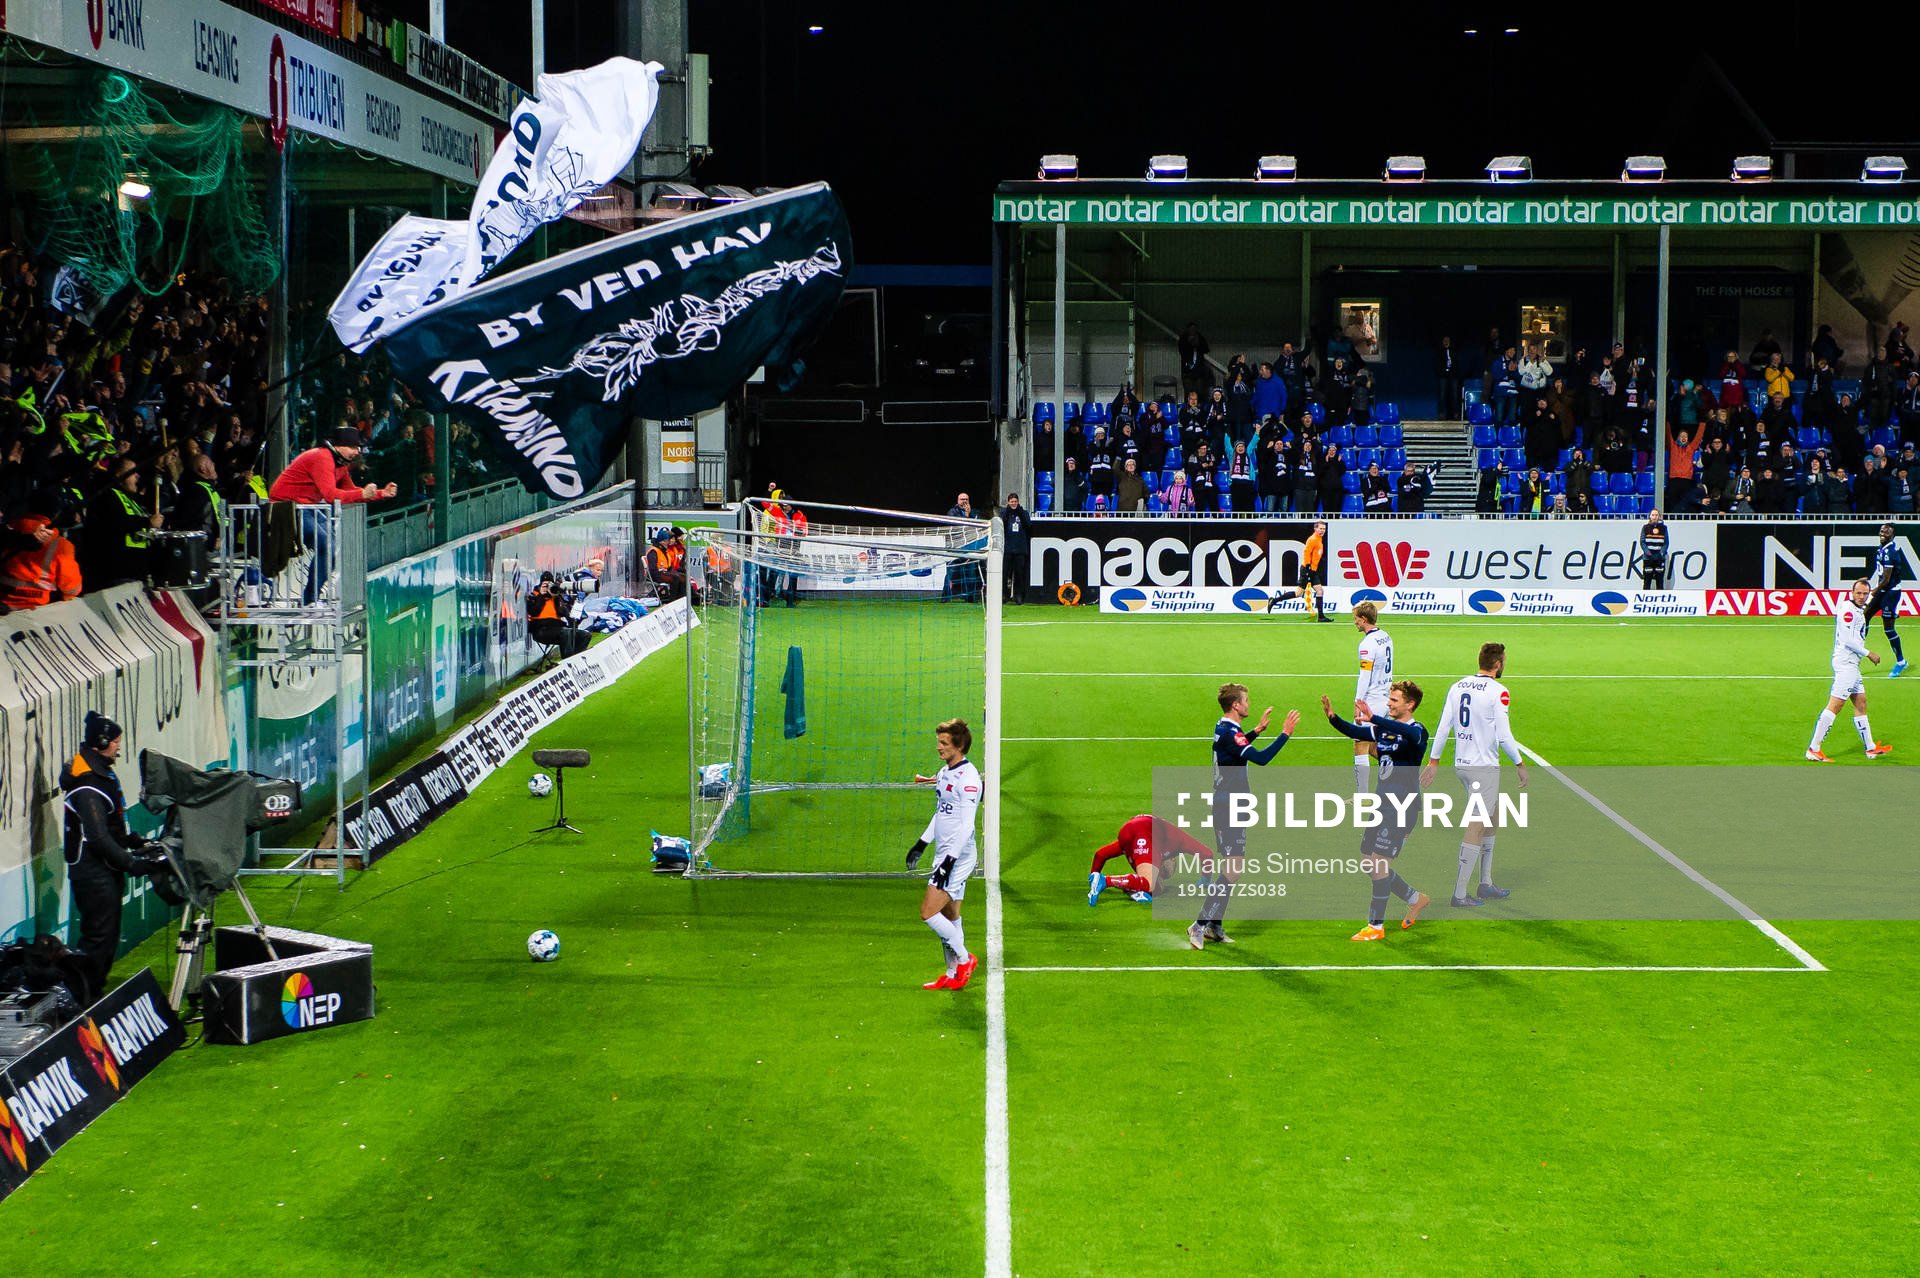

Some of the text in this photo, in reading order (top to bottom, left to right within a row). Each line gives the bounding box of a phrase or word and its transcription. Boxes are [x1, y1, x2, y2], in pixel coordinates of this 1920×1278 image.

[107, 0, 146, 51] BANK
[193, 18, 240, 84] LEASING
[289, 54, 346, 131] TRIBUNEN
[365, 91, 402, 143] REGNSKAP
[1000, 196, 1076, 223] notar
[1088, 196, 1165, 223] notar
[1174, 196, 1252, 223] notar
[1262, 196, 1339, 223] notar
[1349, 196, 1427, 223] notar
[1437, 196, 1514, 223] notar
[1525, 196, 1603, 223] notar
[1613, 196, 1691, 223] notar
[1701, 196, 1779, 223] notar
[1790, 196, 1868, 223] notar
[1695, 287, 1783, 296] THE FISH HOUSE
[477, 303, 544, 349] BY
[1030, 537, 1306, 587] macron
[1447, 539, 1708, 581] west elekro
[1151, 600, 1215, 614] Shipping
[1152, 590, 1195, 601] North
[1391, 600, 1456, 614] Shipping
[1392, 590, 1434, 602] North
[1510, 602, 1574, 615] Shipping
[1511, 592, 1553, 603] North
[1633, 602, 1698, 616] Shipping
[1634, 592, 1677, 603] North
[1708, 591, 1788, 616] AVIS
[1385, 646, 1392, 674] 3
[491, 708, 524, 752] TESS
[527, 679, 562, 719] TESS
[549, 669, 580, 705] TESS
[1459, 693, 1472, 728] 6
[386, 783, 430, 830] macron
[421, 763, 462, 805] macron
[300, 992, 341, 1028] NEP
[100, 991, 169, 1066] RAMVIK
[7, 1056, 89, 1143] RAMVIK
